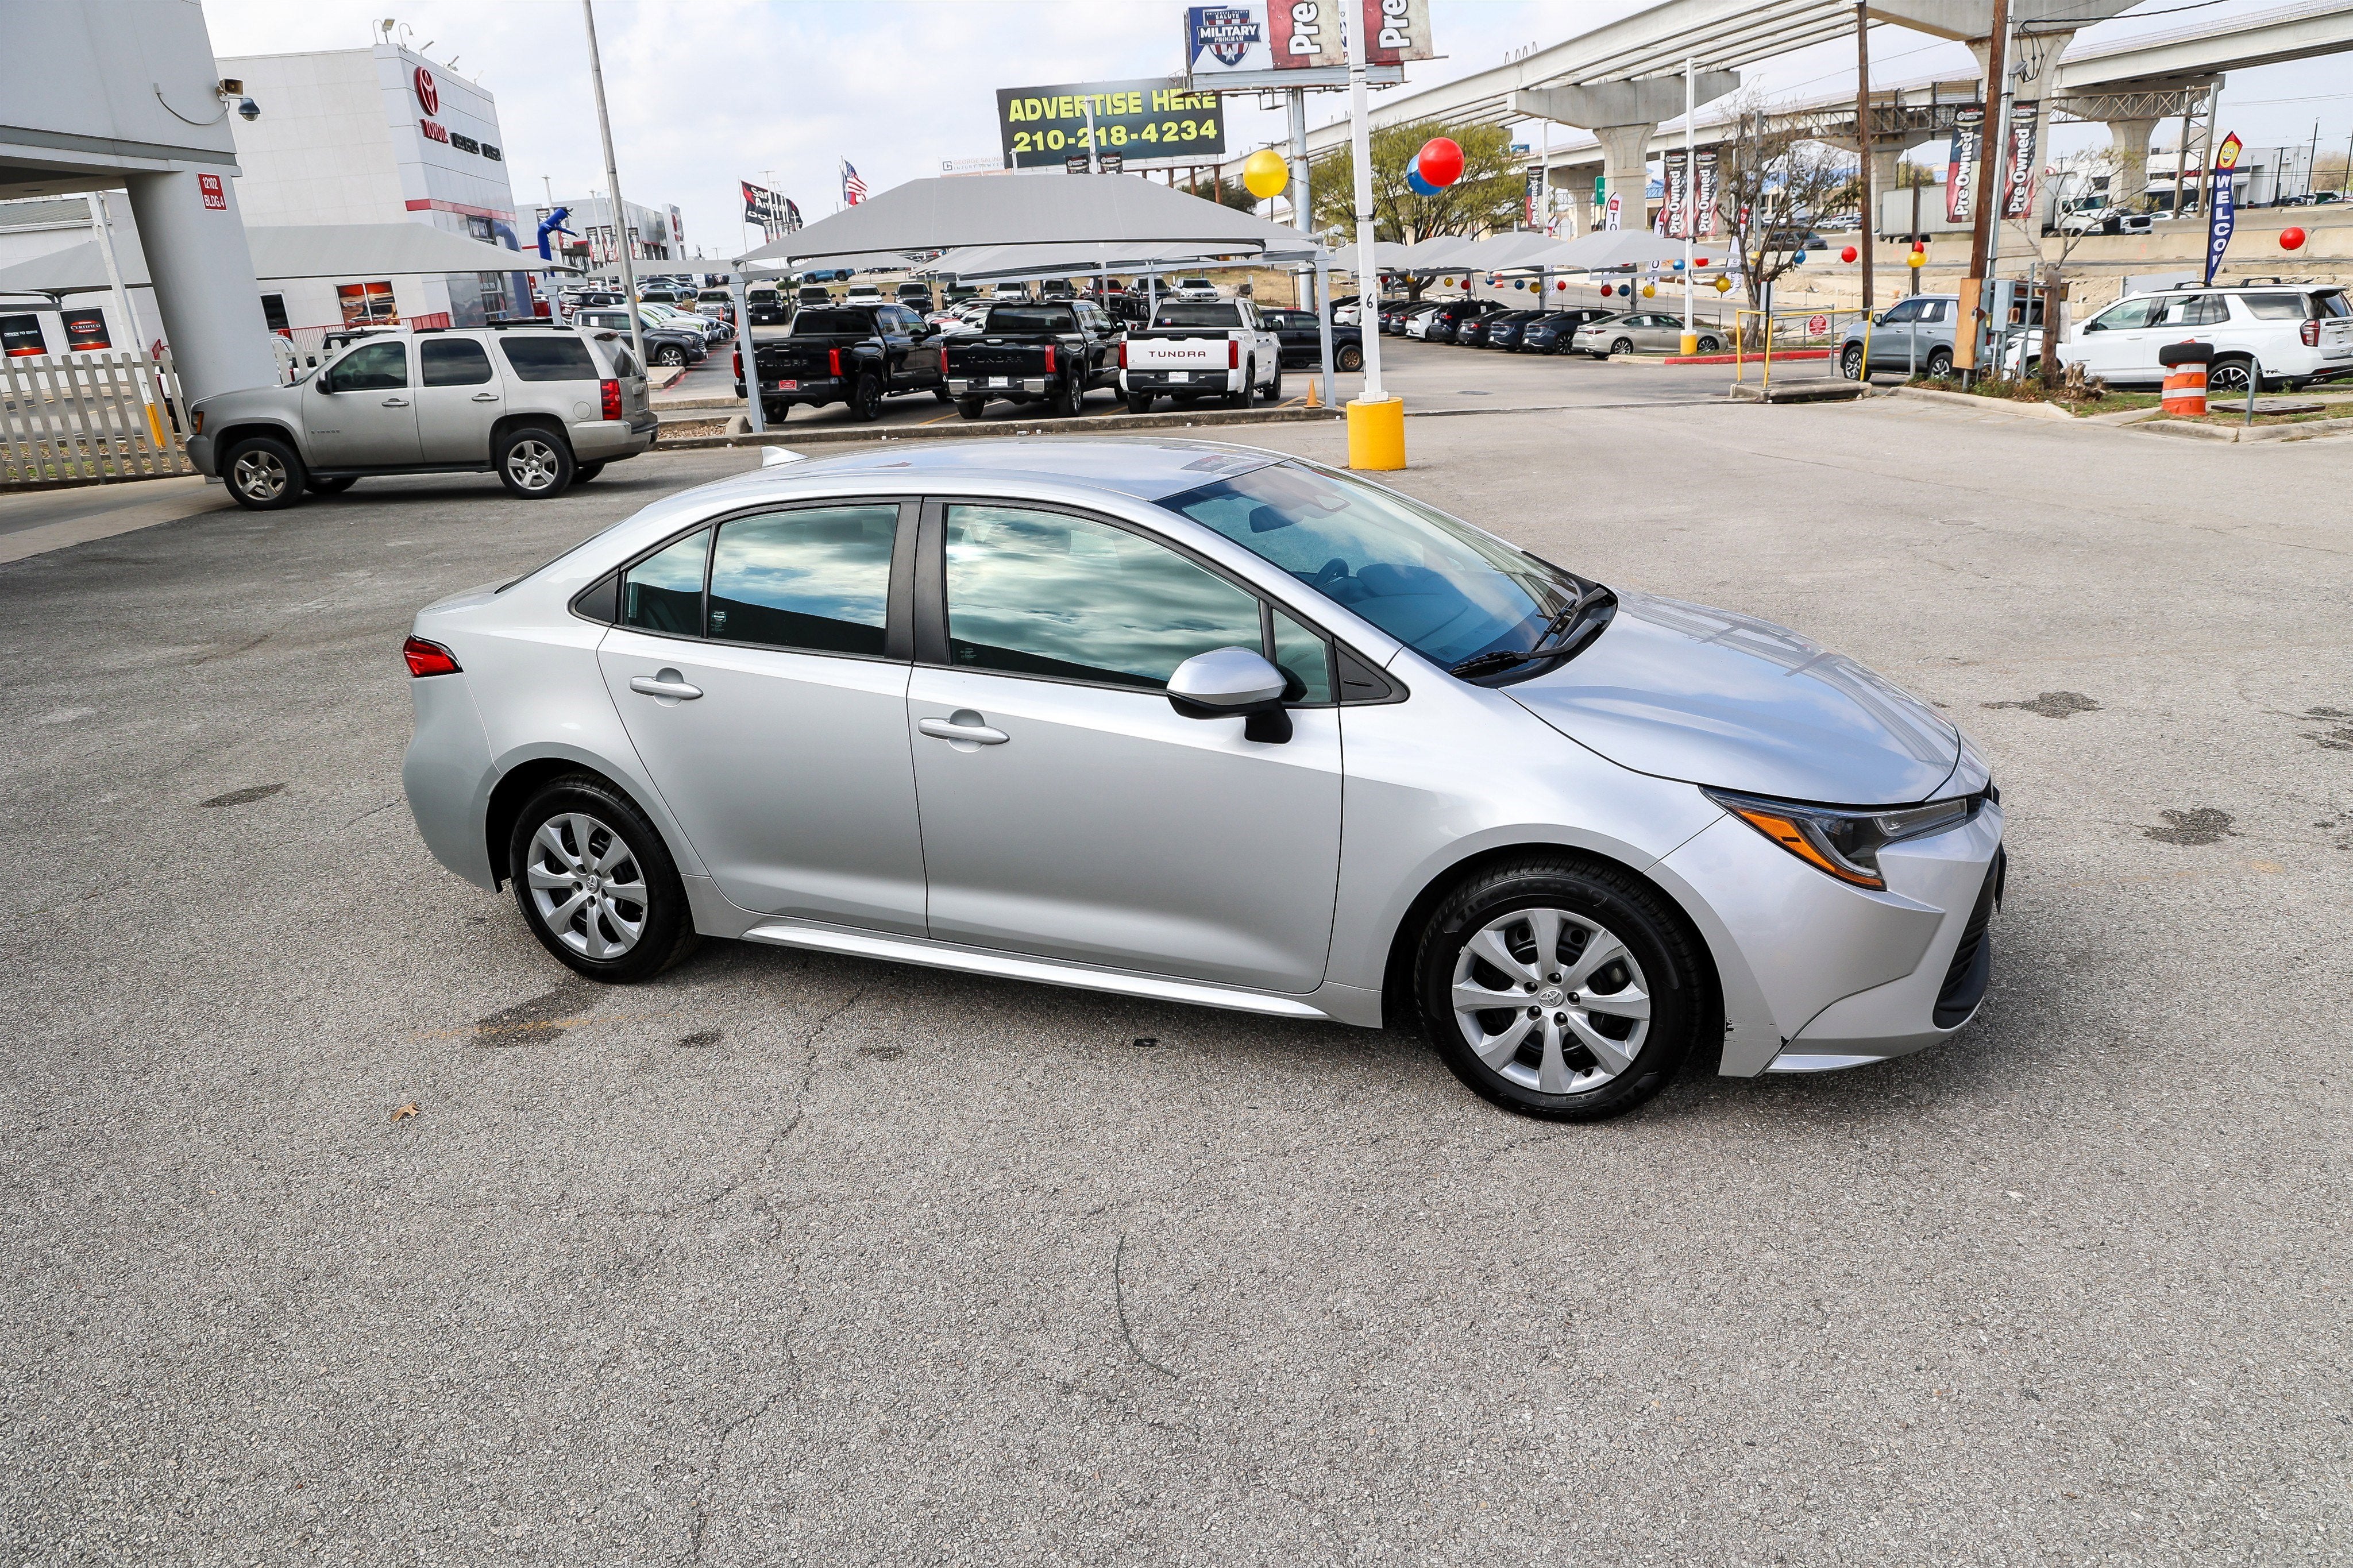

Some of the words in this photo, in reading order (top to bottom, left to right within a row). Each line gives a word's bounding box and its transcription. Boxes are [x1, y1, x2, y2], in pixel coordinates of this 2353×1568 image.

[1201, 25, 1256, 38] MILITARY
[1289, 2, 1322, 55] Pre
[1379, 0, 1410, 48] Pre
[1009, 91, 1143, 122] ADVERTISE
[1152, 88, 1217, 113] HERE
[424, 119, 448, 142] TOYOTA
[1013, 119, 1217, 152] 210-218-4234
[1954, 132, 1974, 187] Owned
[2012, 128, 2030, 184] Owned
[202, 176, 219, 190] 12102
[1530, 180, 1538, 210] Owned
[1668, 171, 1681, 212] Owned
[1698, 169, 1711, 211] Owned
[1954, 189, 1969, 215] Pre
[2008, 186, 2026, 213] Pre
[1669, 213, 1681, 234] Pre
[1699, 211, 1710, 232] Pre
[1366, 293, 1374, 309] 6
